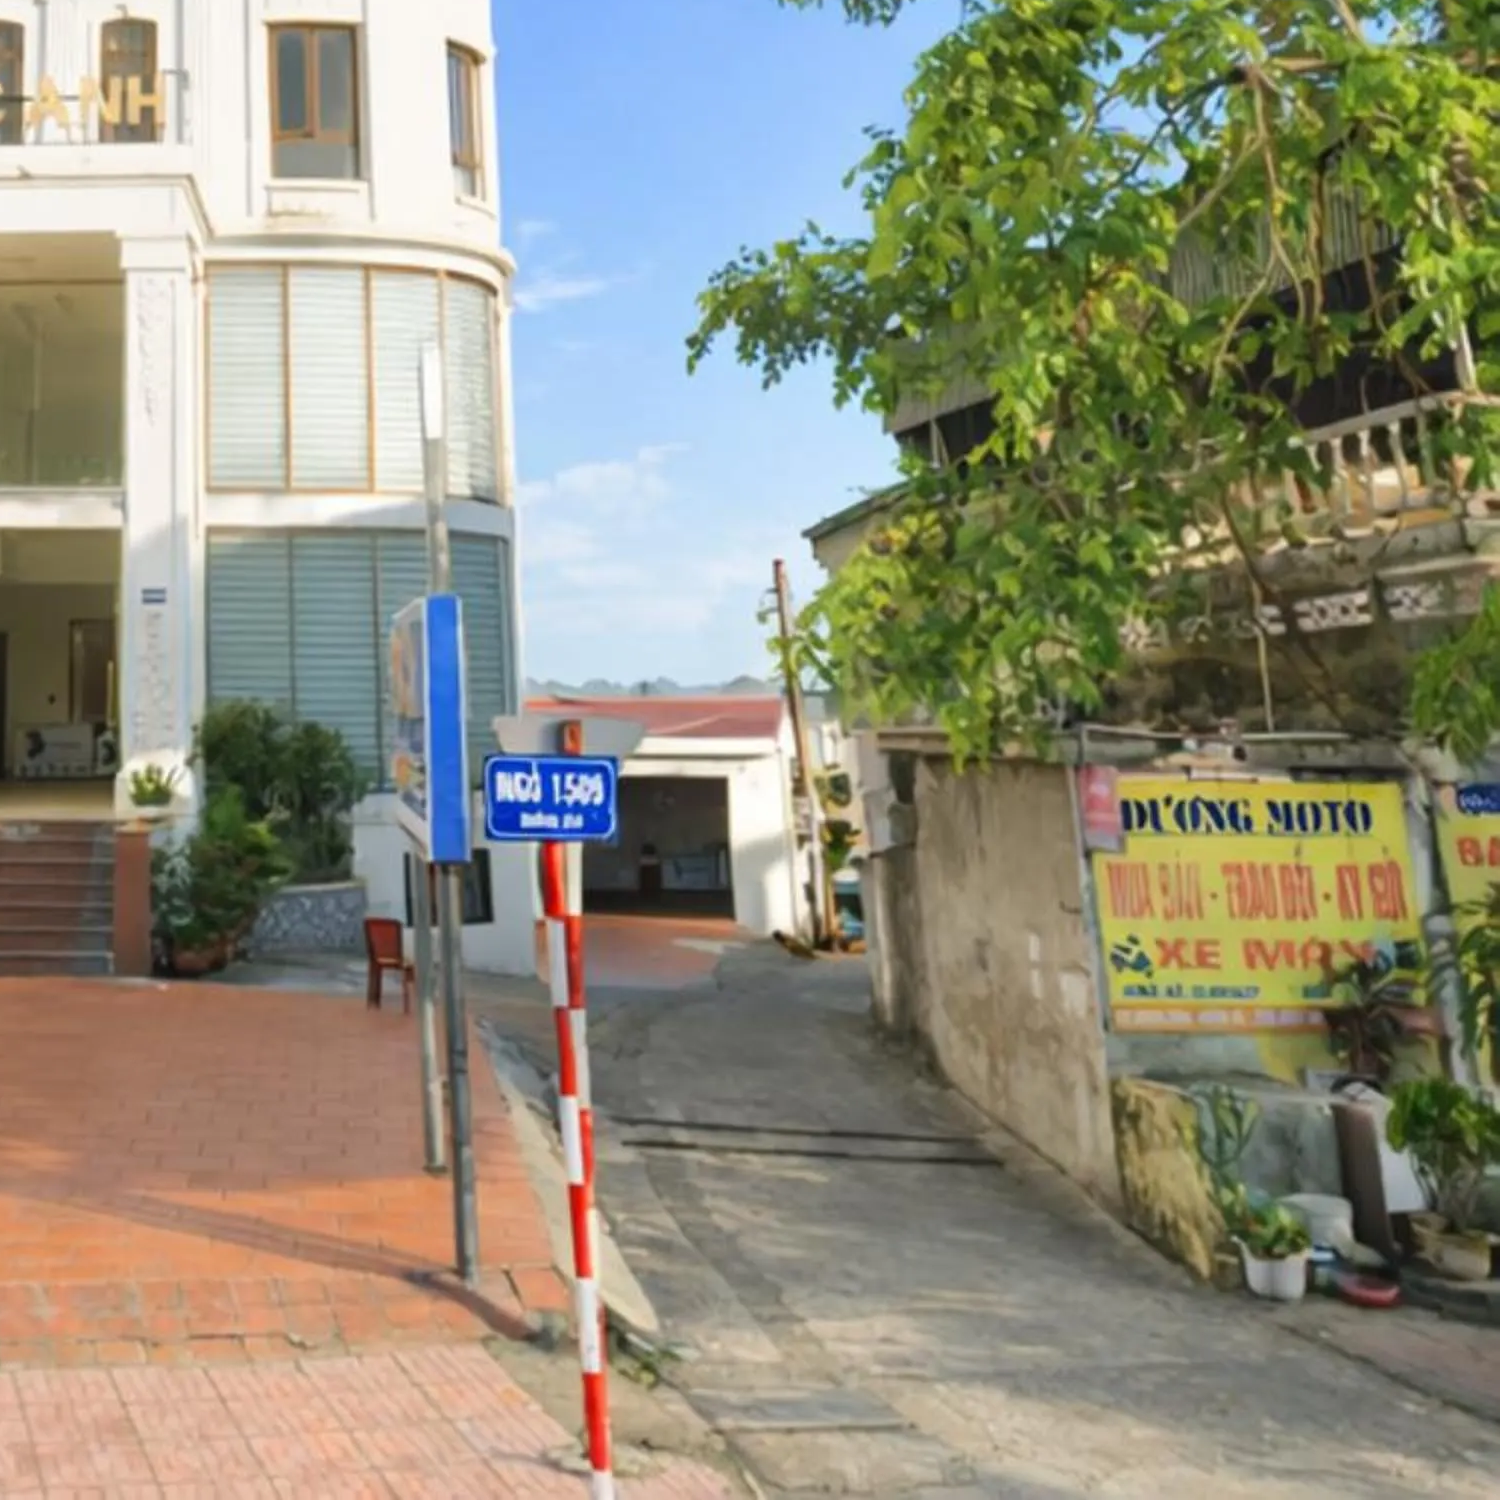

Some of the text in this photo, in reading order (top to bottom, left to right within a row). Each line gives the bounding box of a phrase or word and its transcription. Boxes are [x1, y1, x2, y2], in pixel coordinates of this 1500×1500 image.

[23, 73, 166, 129] ANH
[1266, 799, 1373, 835] MOTO
[1156, 937, 1222, 971] XE
